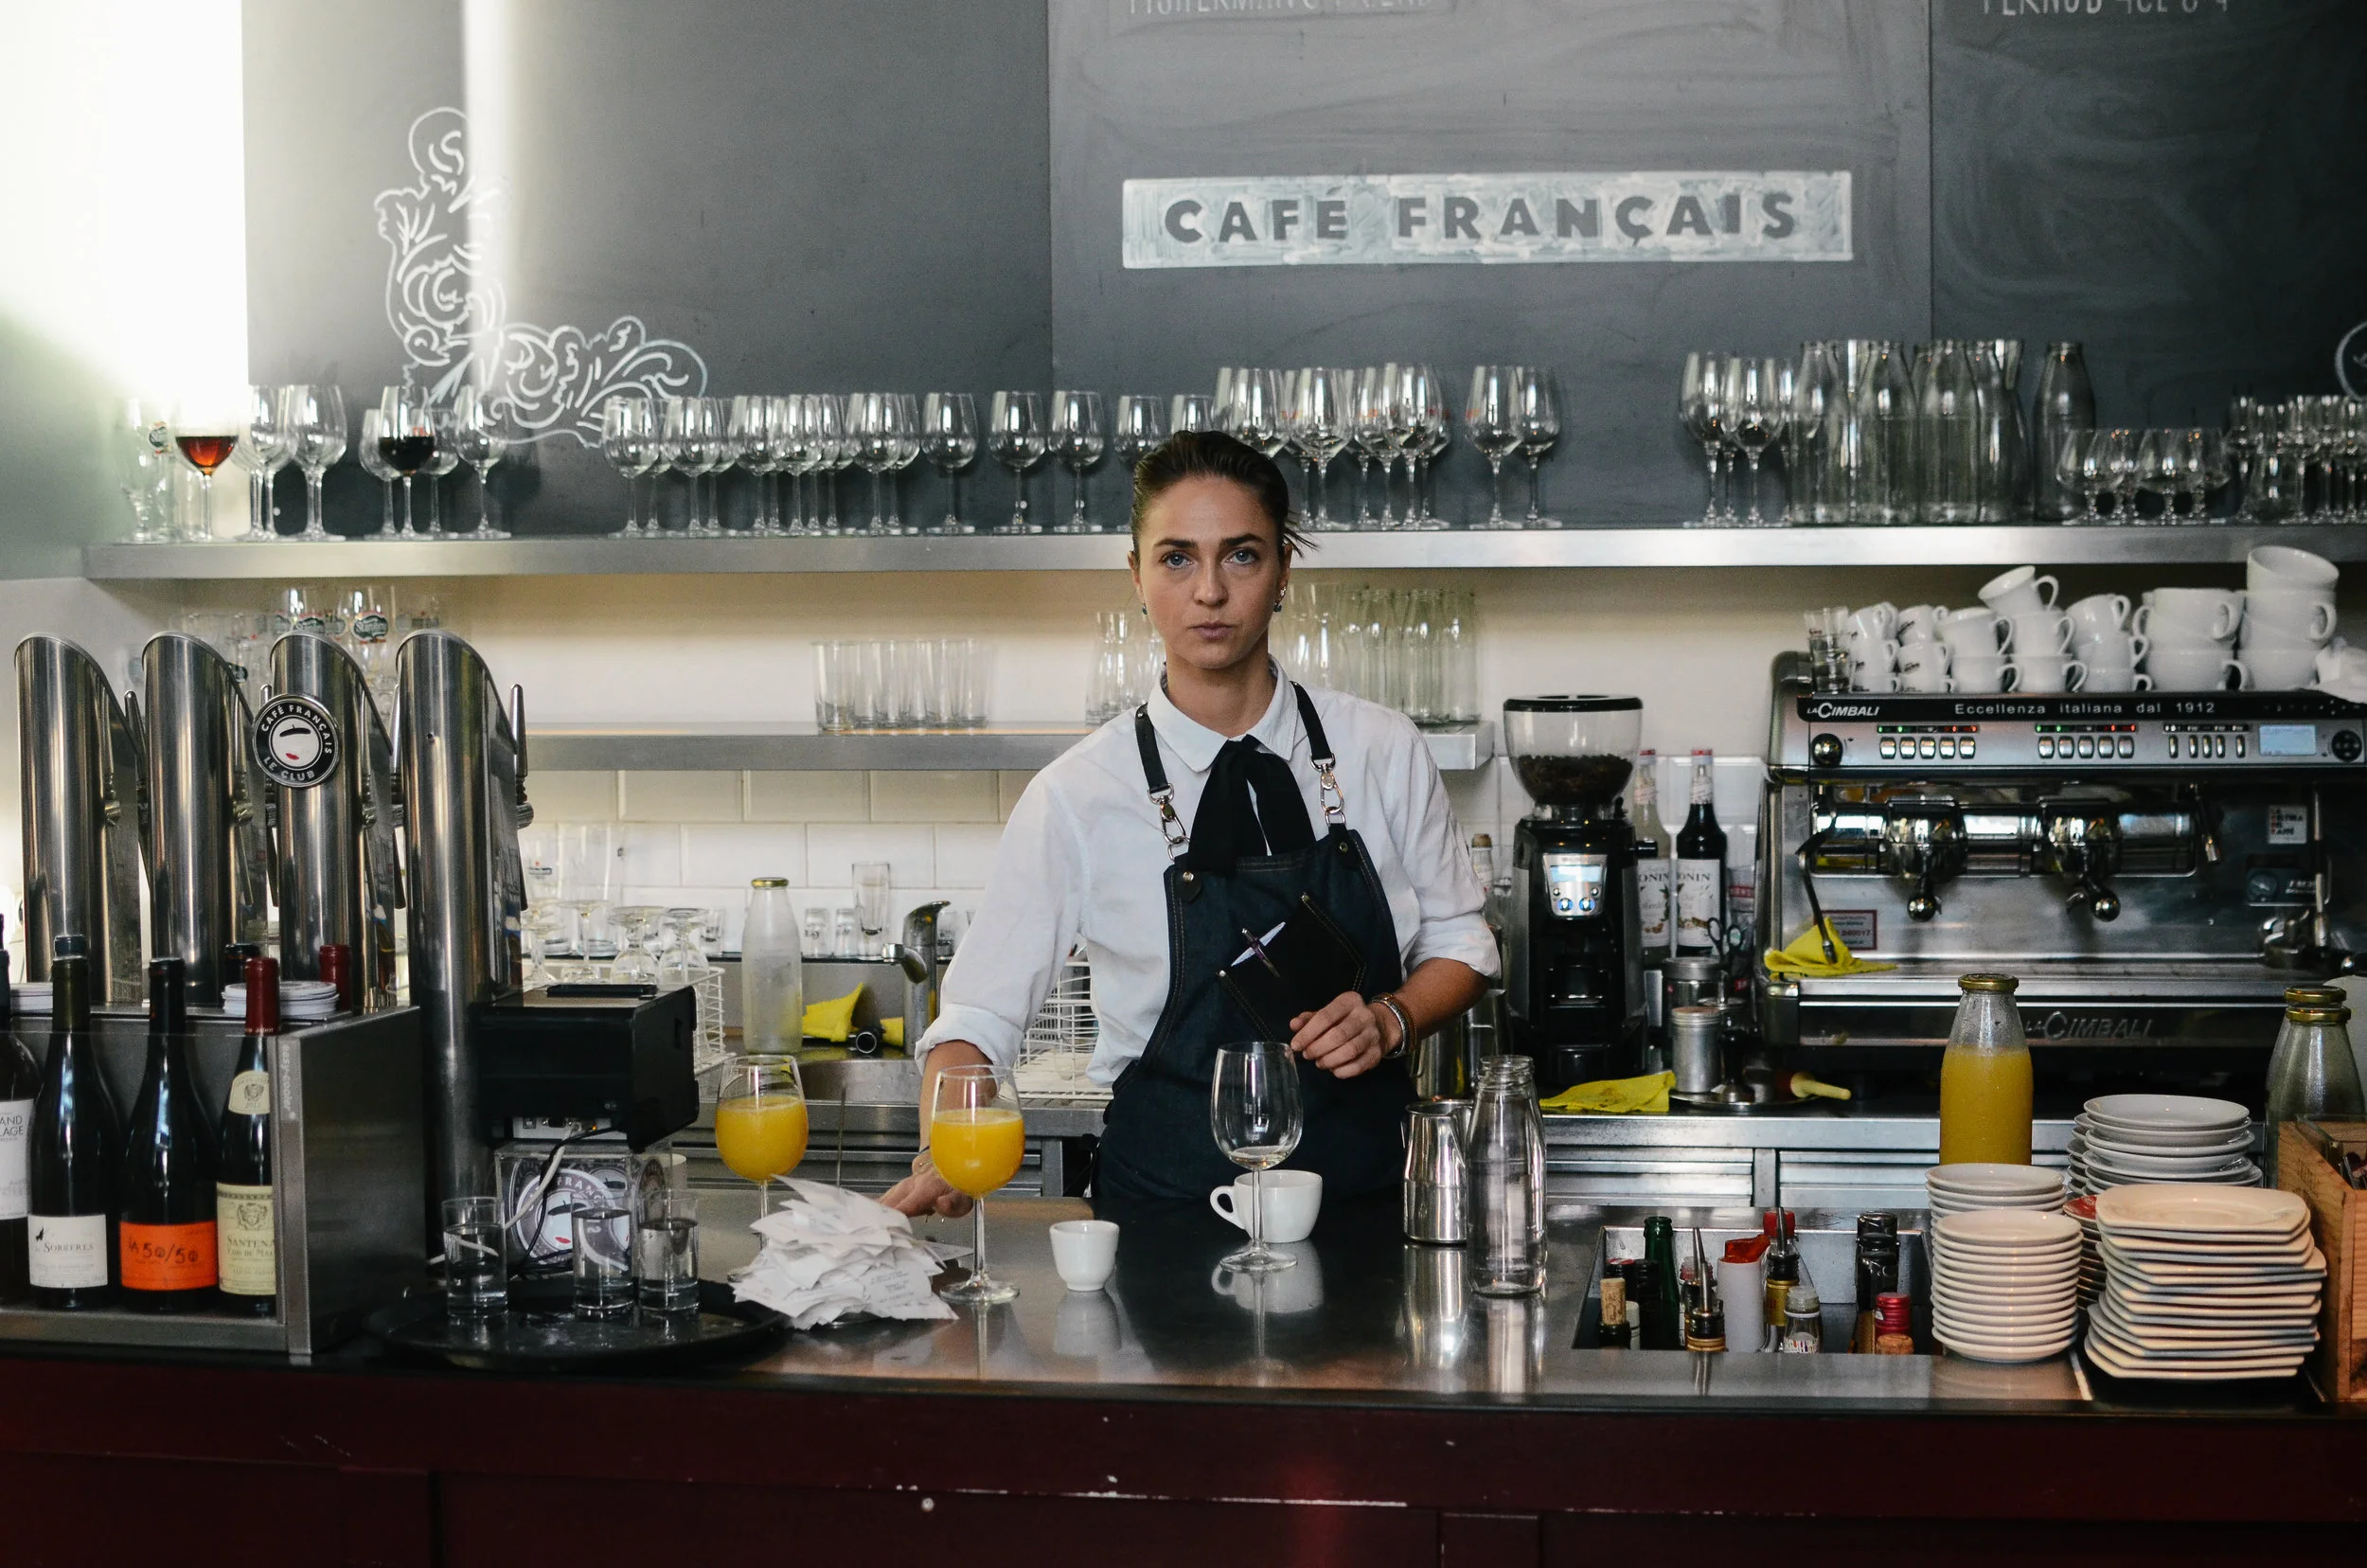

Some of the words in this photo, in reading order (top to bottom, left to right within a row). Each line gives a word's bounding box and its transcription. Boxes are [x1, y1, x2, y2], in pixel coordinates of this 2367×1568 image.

[1397, 194, 1796, 246] FRANÇAIS
[1955, 704, 2046, 714] Eccellenza
[2059, 703, 2122, 713] italiana
[2136, 703, 2161, 713] dal
[2176, 703, 2215, 713] 1912
[261, 705, 284, 732] CAFÉ
[289, 704, 332, 754] FRANÇAIS
[263, 757, 277, 771] LE
[280, 770, 314, 781] CLUB
[1639, 874, 1669, 882] ONIN
[1678, 873, 1711, 882] ONIN
